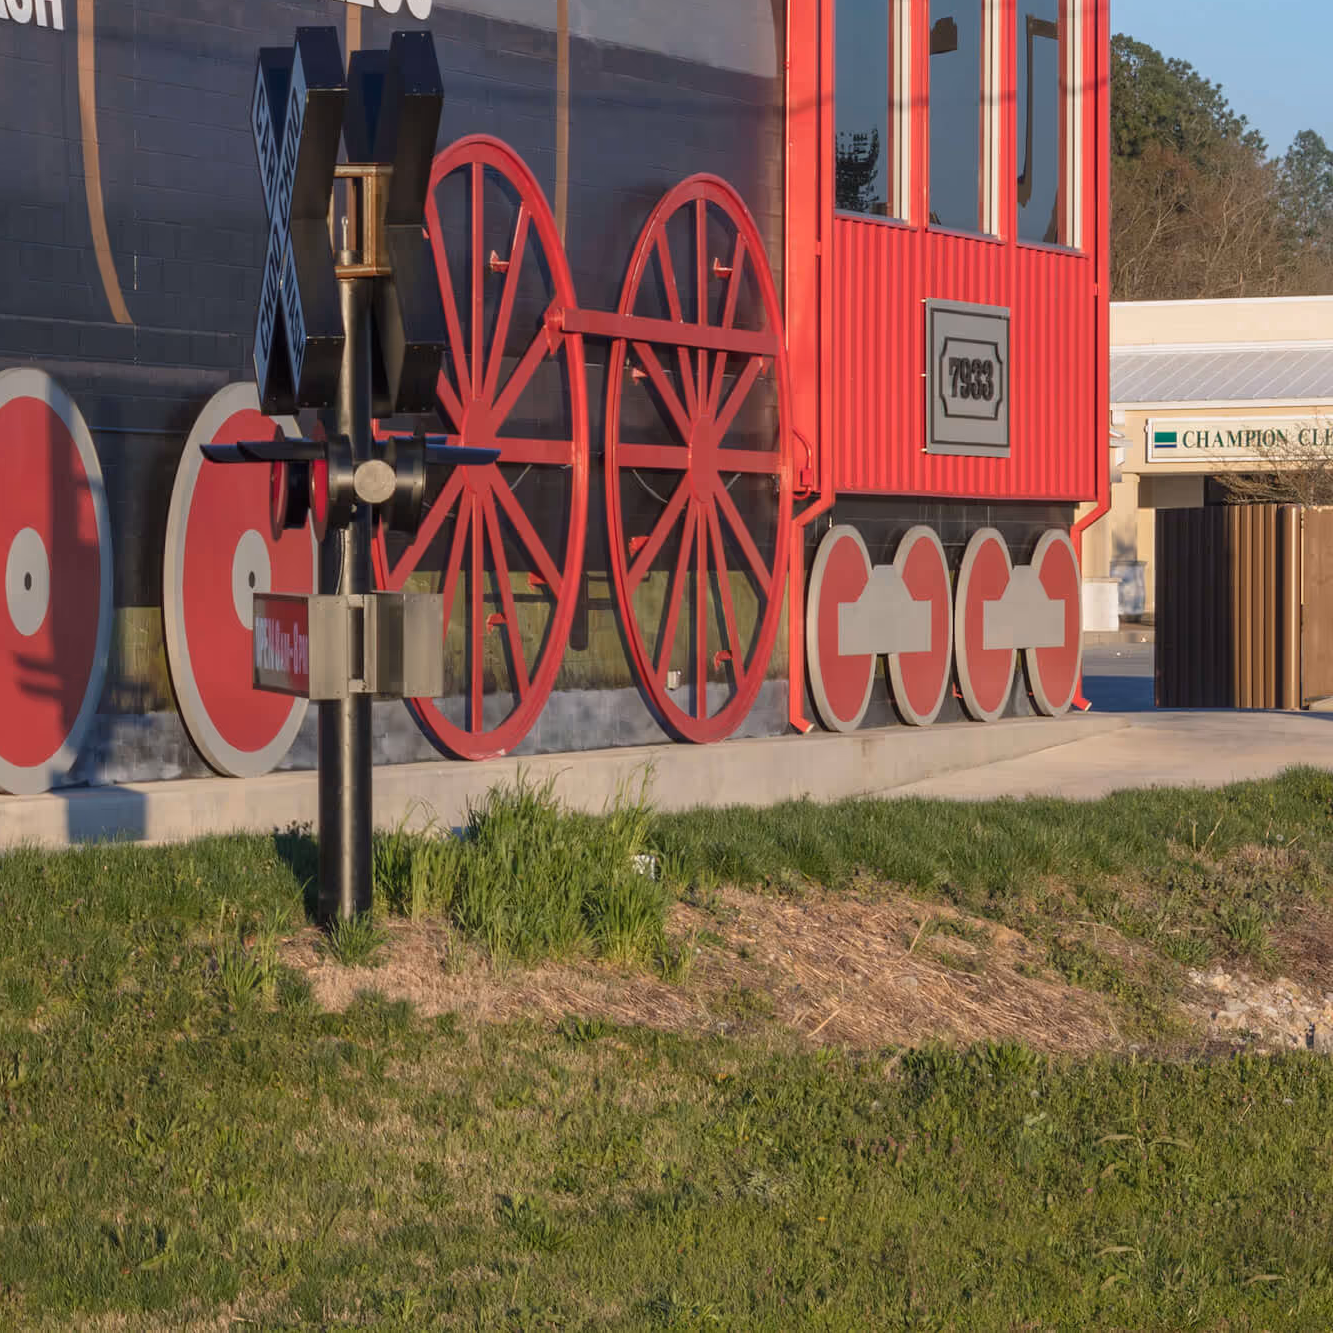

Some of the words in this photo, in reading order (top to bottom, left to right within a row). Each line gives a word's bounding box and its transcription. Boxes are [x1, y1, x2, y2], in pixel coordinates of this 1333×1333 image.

[256, 82, 276, 199] CAR
[285, 253, 304, 377] WASH
[260, 220, 282, 362] CHOO
[278, 85, 301, 230] CHOO
[949, 357, 994, 401] 7933
[1183, 429, 1288, 448] CHAMPION
